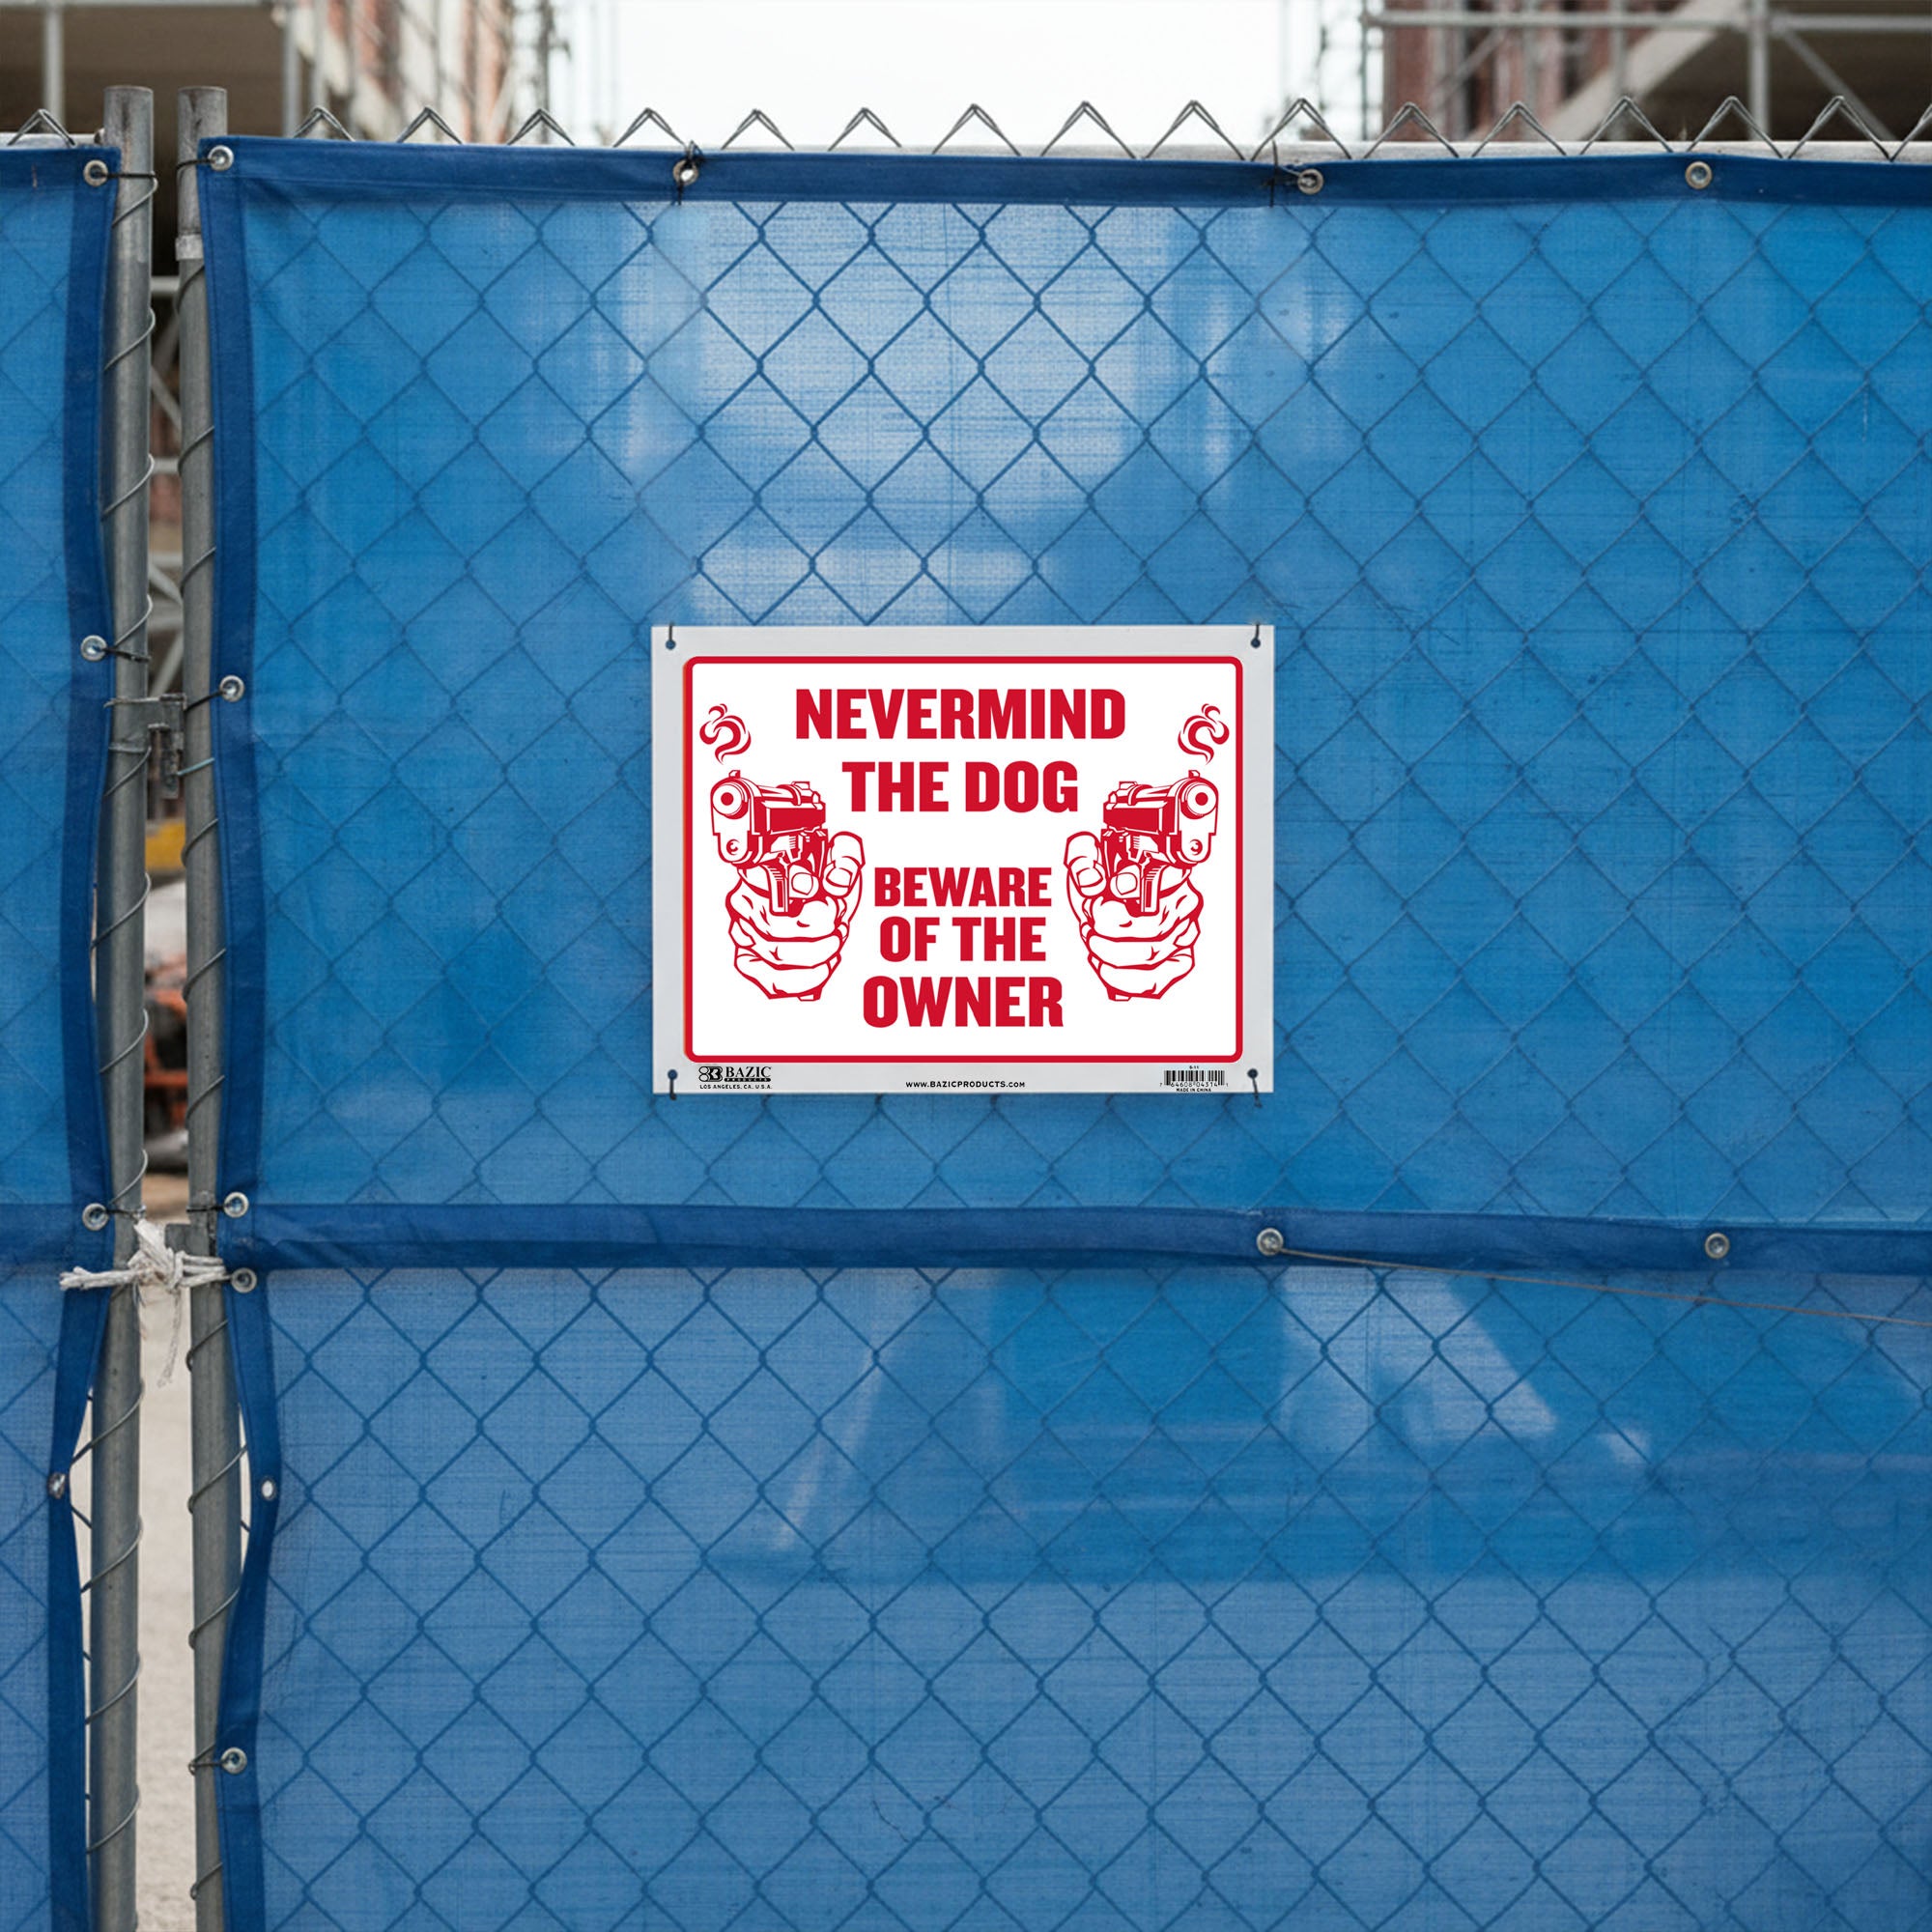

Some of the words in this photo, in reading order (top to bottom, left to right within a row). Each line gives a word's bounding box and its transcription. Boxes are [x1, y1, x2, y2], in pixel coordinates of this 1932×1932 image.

[795, 688, 1126, 740] NEVERMIND
[841, 761, 950, 813] THE
[965, 760, 1079, 813] DOG
[874, 867, 1052, 907] BEWARE
[879, 916, 941, 963] OF
[952, 916, 1047, 963] THE
[863, 976, 1064, 1029] OWNER
[725, 1065, 772, 1078] BAZIC
